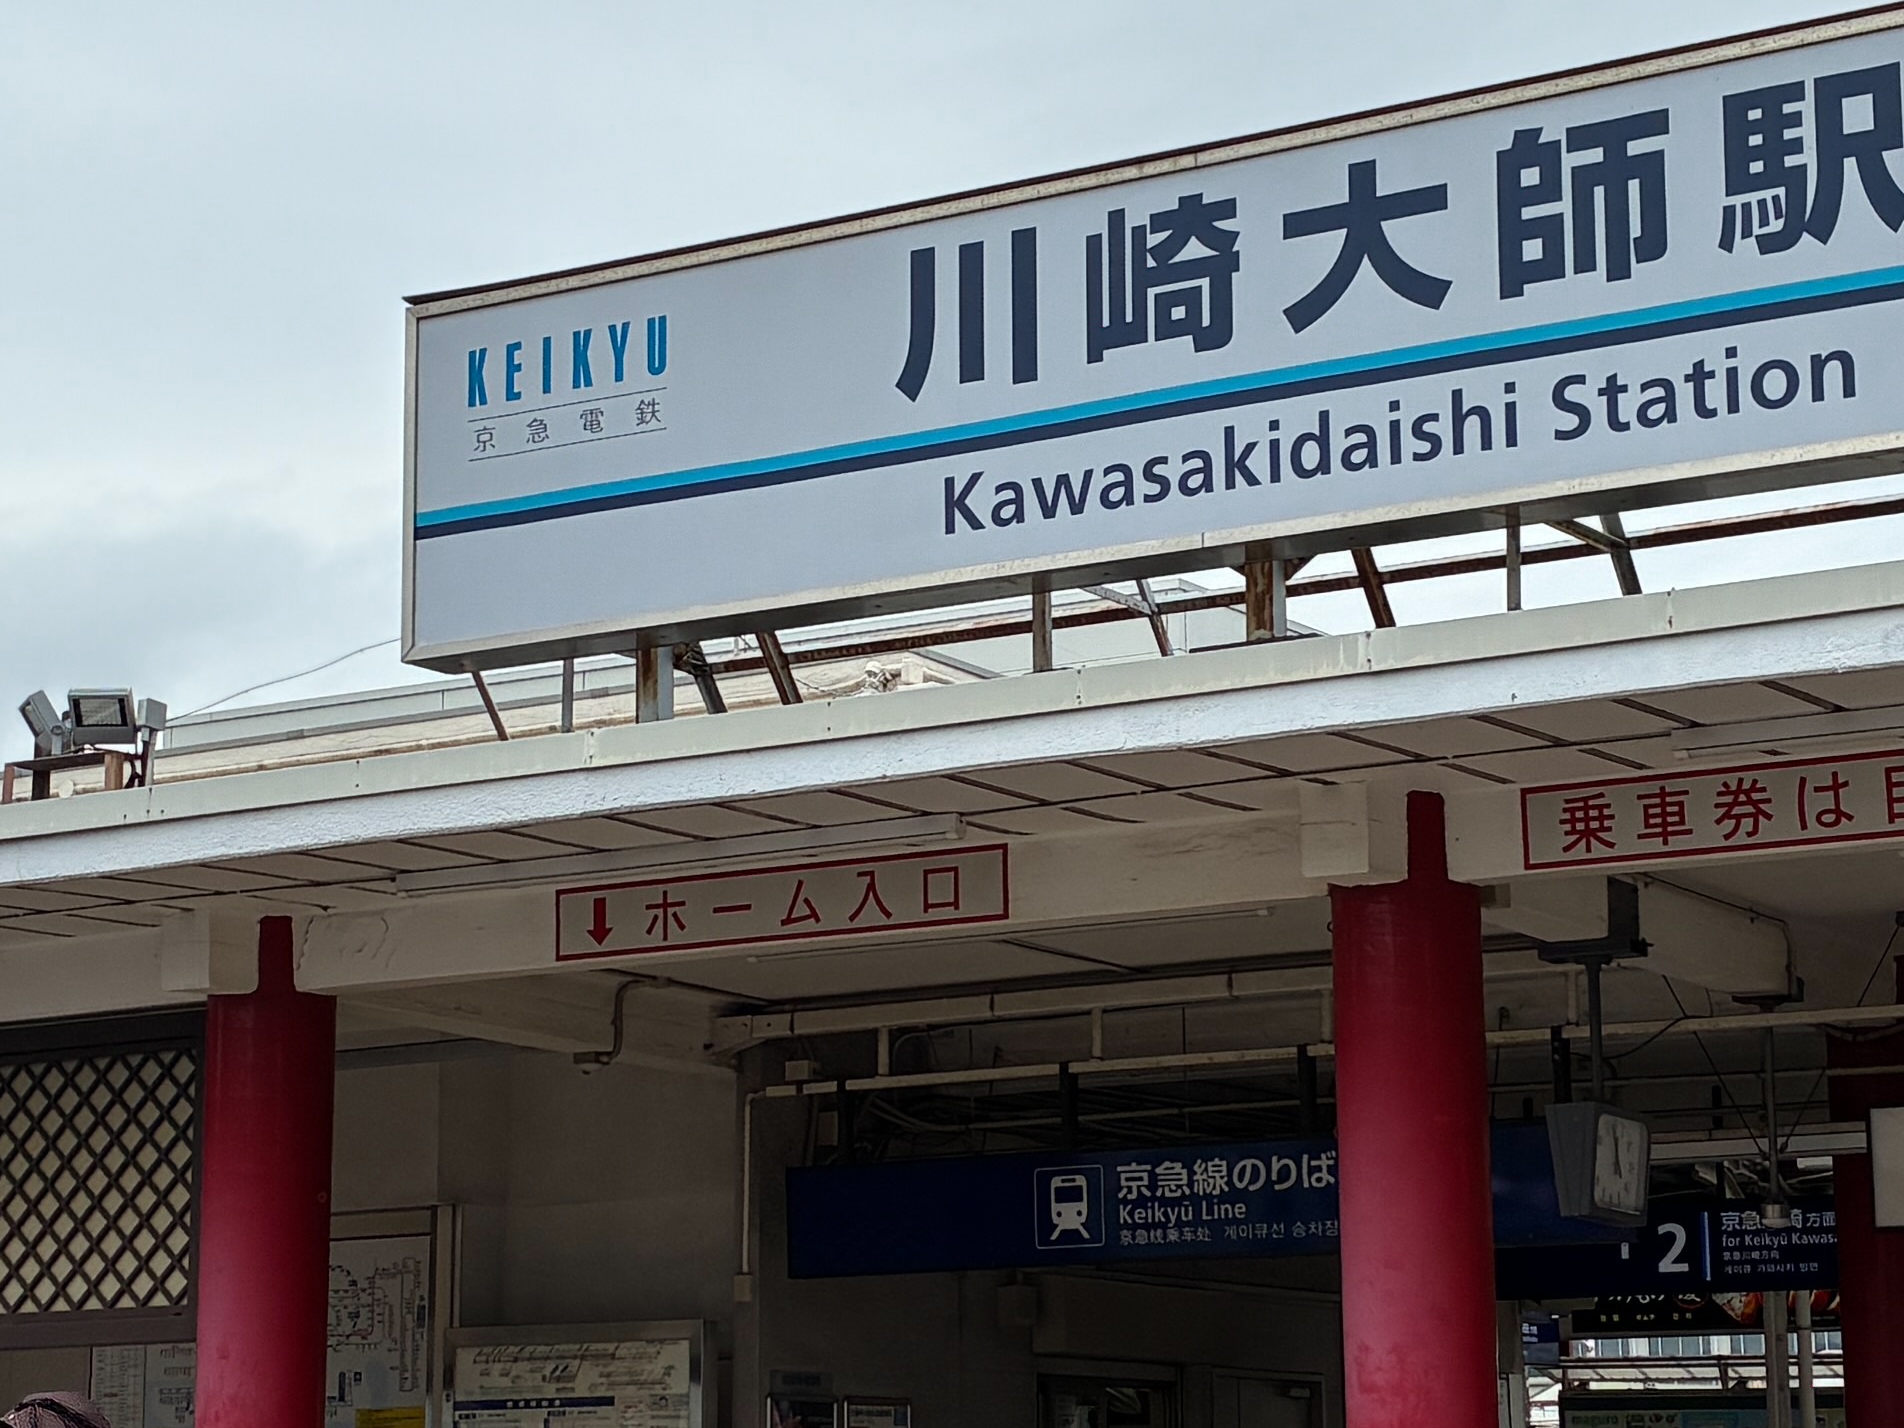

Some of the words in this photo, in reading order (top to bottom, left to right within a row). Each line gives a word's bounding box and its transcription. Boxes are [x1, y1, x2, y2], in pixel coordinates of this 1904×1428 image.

[468, 315, 667, 407] KEIKYU
[473, 398, 662, 453] 京急電鉄
[944, 382, 1518, 534] Kawasakidaishi
[1553, 345, 1856, 440] Station
[645, 865, 960, 941] ホーム入口
[1117, 1151, 1337, 1200] 京急線のりば
[1119, 1200, 1193, 1228] Keikyū
[1201, 1199, 1246, 1220] Line
[1657, 1222, 1690, 1274] 2
[1722, 1234, 1740, 1247] for
